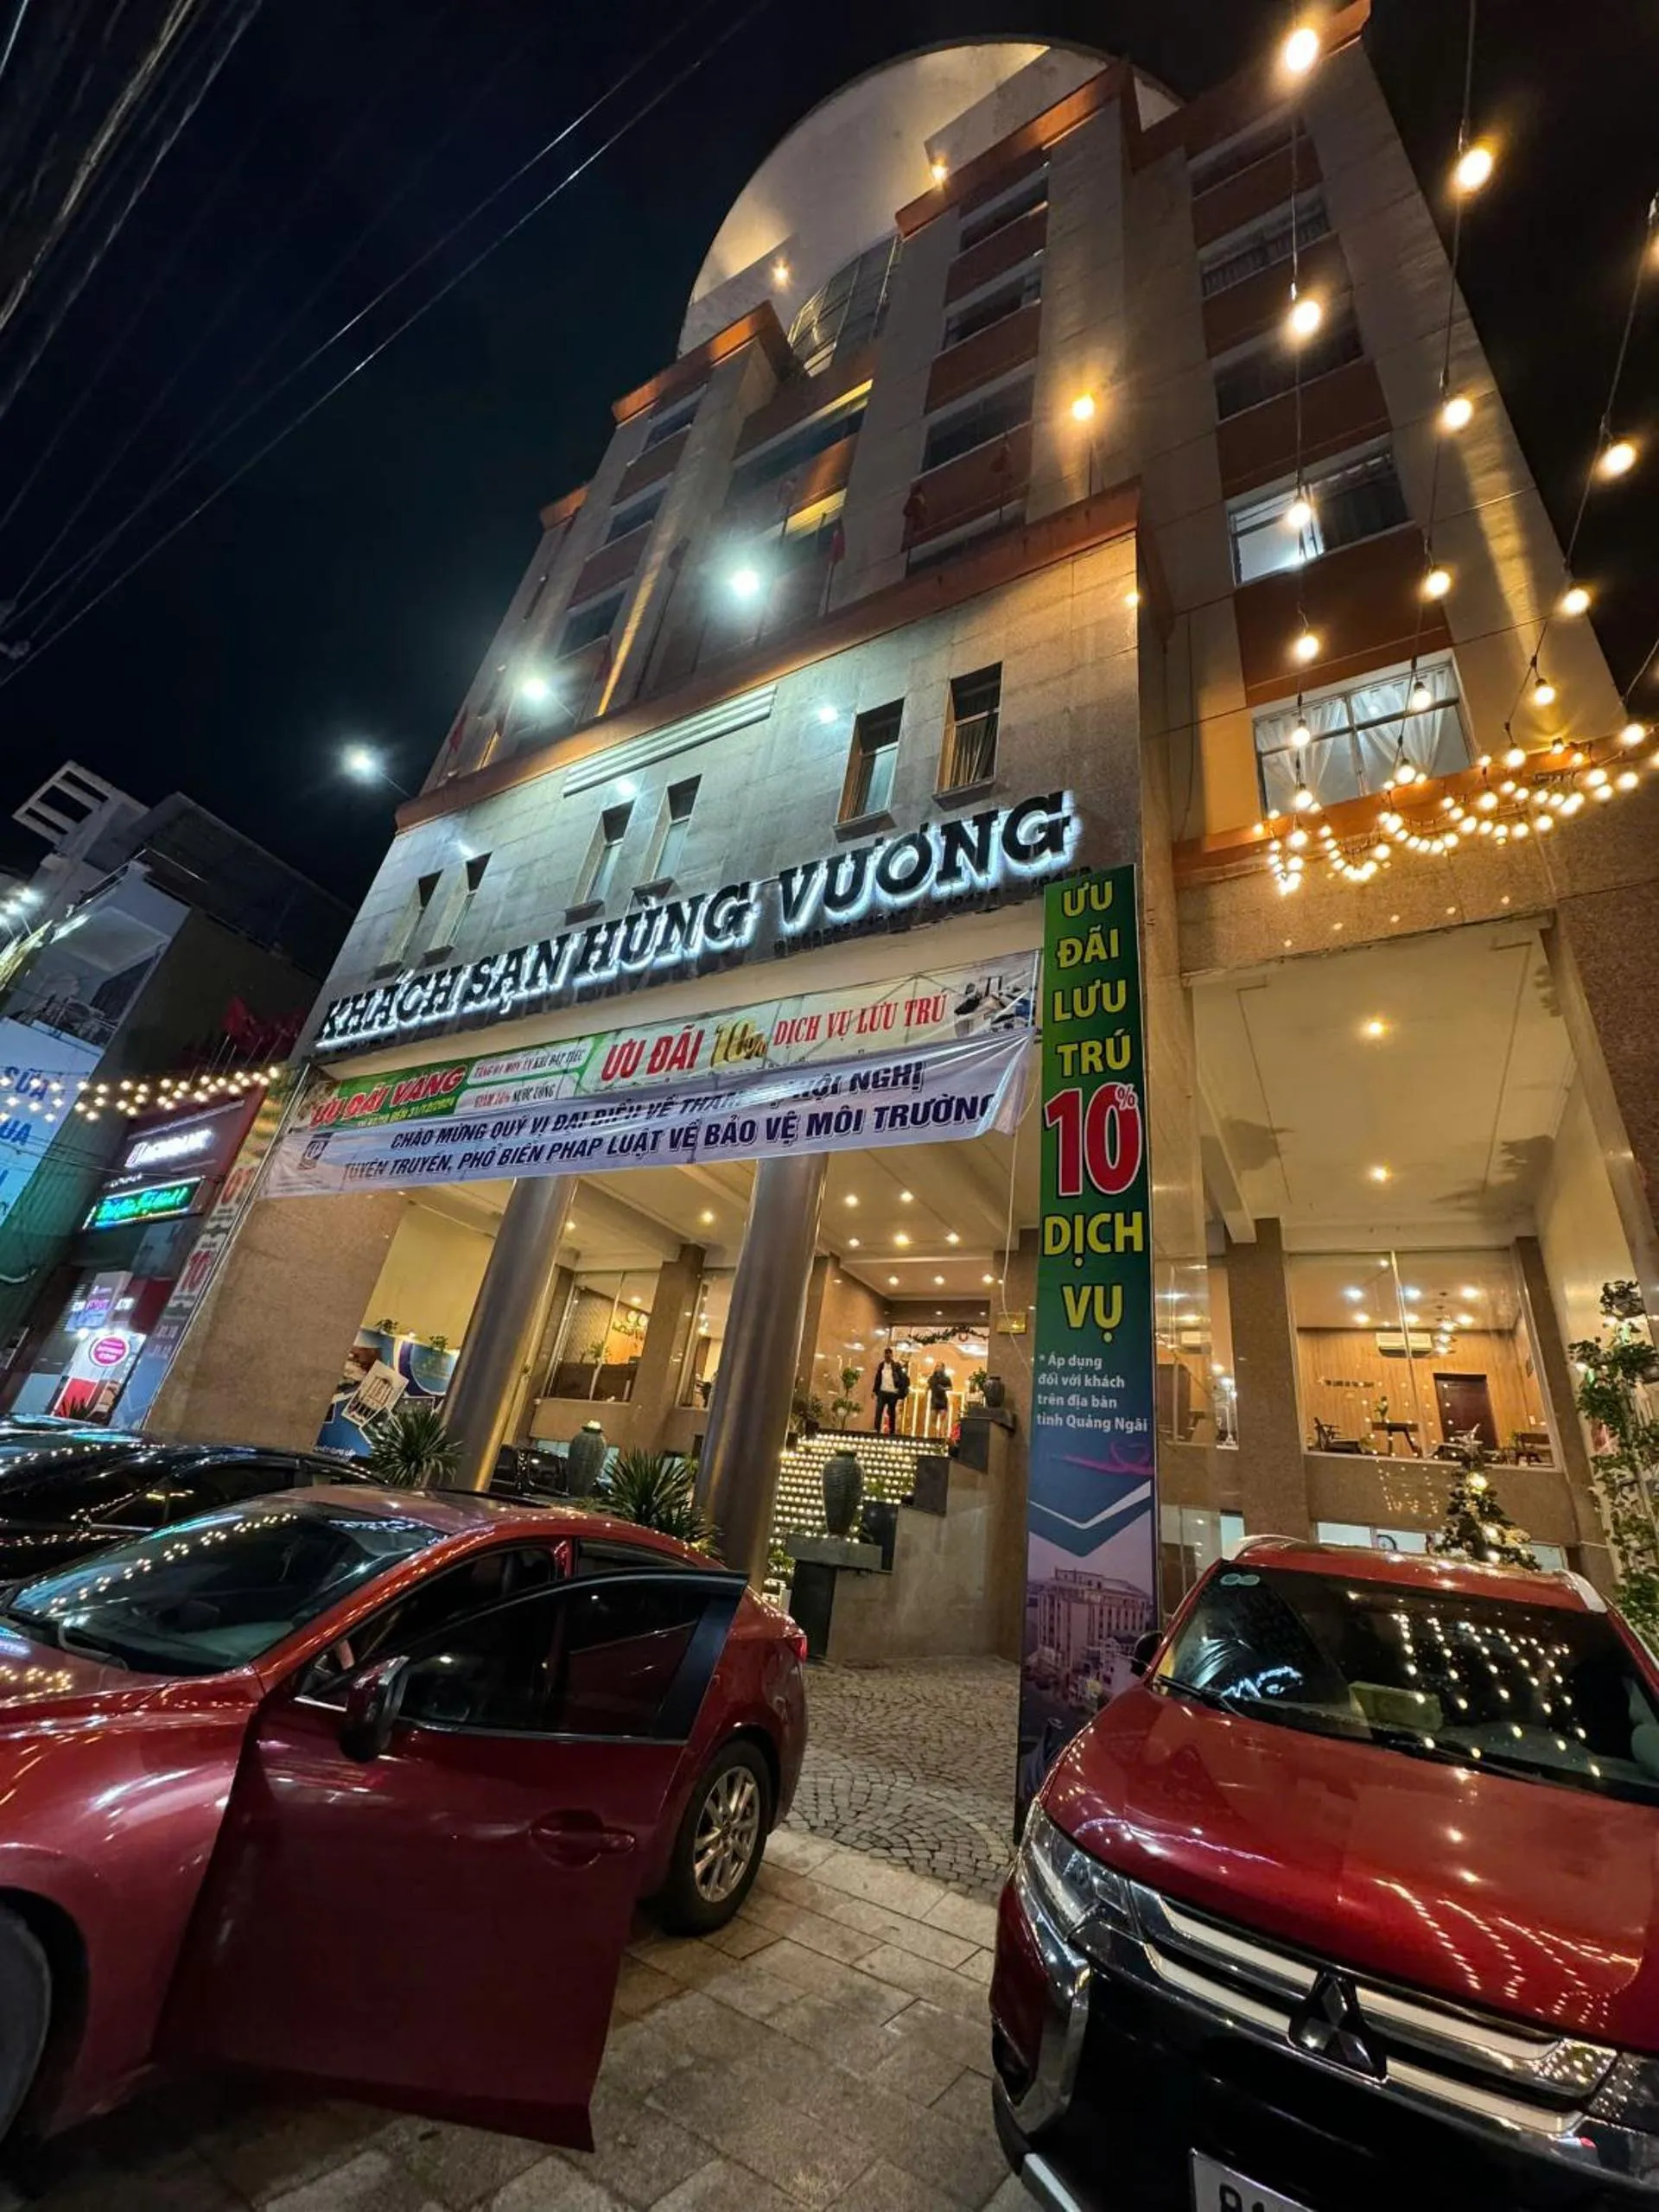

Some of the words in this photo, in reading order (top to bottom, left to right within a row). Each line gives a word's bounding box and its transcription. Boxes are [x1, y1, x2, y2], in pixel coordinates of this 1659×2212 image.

[315, 967, 465, 1047] KHÁCH
[460, 934, 579, 1015] SẠN
[572, 880, 760, 986] HÙNG
[778, 790, 1077, 931] VƯƠNG
[1063, 880, 1113, 918] ƯU
[1058, 924, 1119, 969] ĐÃI
[1053, 979, 1127, 1022] LƯU
[601, 1037, 645, 1081] ƯU
[647, 1024, 705, 1075] ĐÃI
[773, 1014, 822, 1048] DỊCH
[826, 1009, 855, 1040] VỤ
[856, 1001, 899, 1034] LƯU
[1057, 1028, 1131, 1077] TRÚ
[390, 1065, 467, 1107] VÀNG
[391, 1127, 434, 1150] CHÀO
[435, 1122, 488, 1145] MỪNG
[490, 1115, 528, 1141] QUÝ
[530, 1111, 550, 1137] VỊ
[849, 1061, 924, 1093] NGHỊ
[456, 1142, 503, 1171] PHỔ
[497, 1141, 545, 1166] BIẾN
[607, 1128, 664, 1157] LUẬT
[669, 1118, 701, 1150] VỀ
[704, 1114, 758, 1147] BẢO
[766, 1109, 798, 1145] VỆ
[805, 1103, 865, 1135] MÔI
[1043, 1211, 1144, 1268] DỊCH
[1062, 1285, 1123, 1343] VỤ
[1038, 1372, 1058, 1386] đối
[1061, 1374, 1081, 1388] với
[1084, 1376, 1125, 1389] khách
[1047, 1351, 1065, 1369] Áp
[1068, 1354, 1103, 1370] dụng
[1038, 1394, 1065, 1407] trên
[1067, 1394, 1089, 1409] địa
[1091, 1395, 1117, 1409] bàn
[1065, 1414, 1111, 1433] Quảng
[1114, 1416, 1147, 1434] Ngãi
